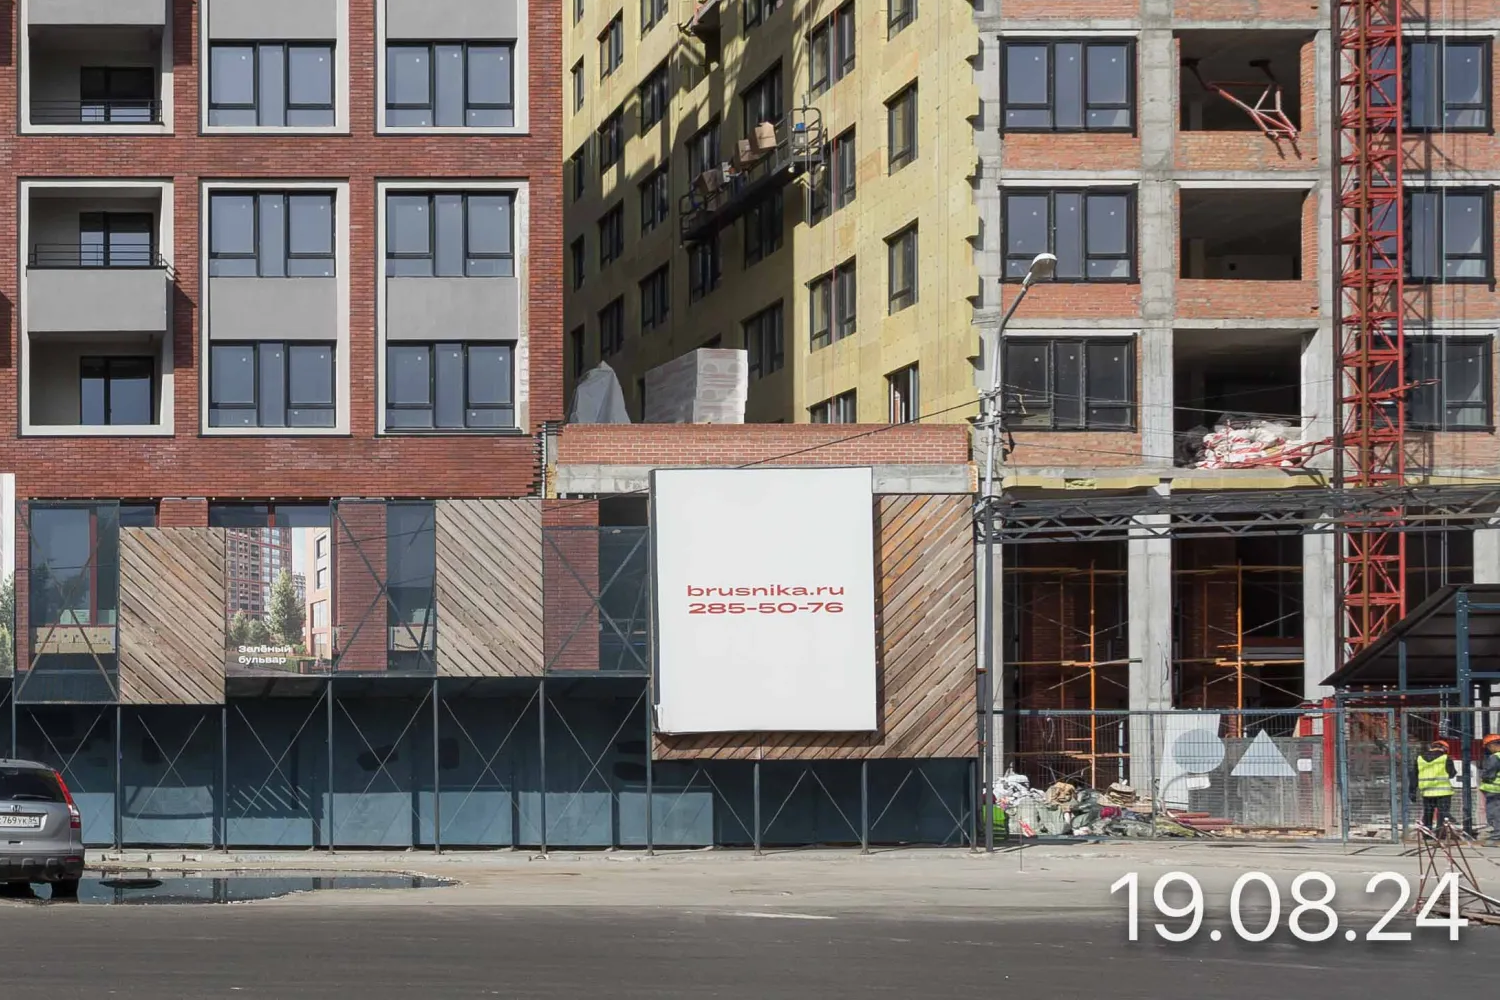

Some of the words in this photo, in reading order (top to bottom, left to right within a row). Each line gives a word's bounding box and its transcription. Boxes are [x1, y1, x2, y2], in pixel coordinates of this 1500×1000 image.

[687, 584, 844, 597] brusnika.ru
[688, 602, 844, 614] 285-50-76
[238, 644, 292, 653] Зелёный
[238, 655, 287, 665] бульвар
